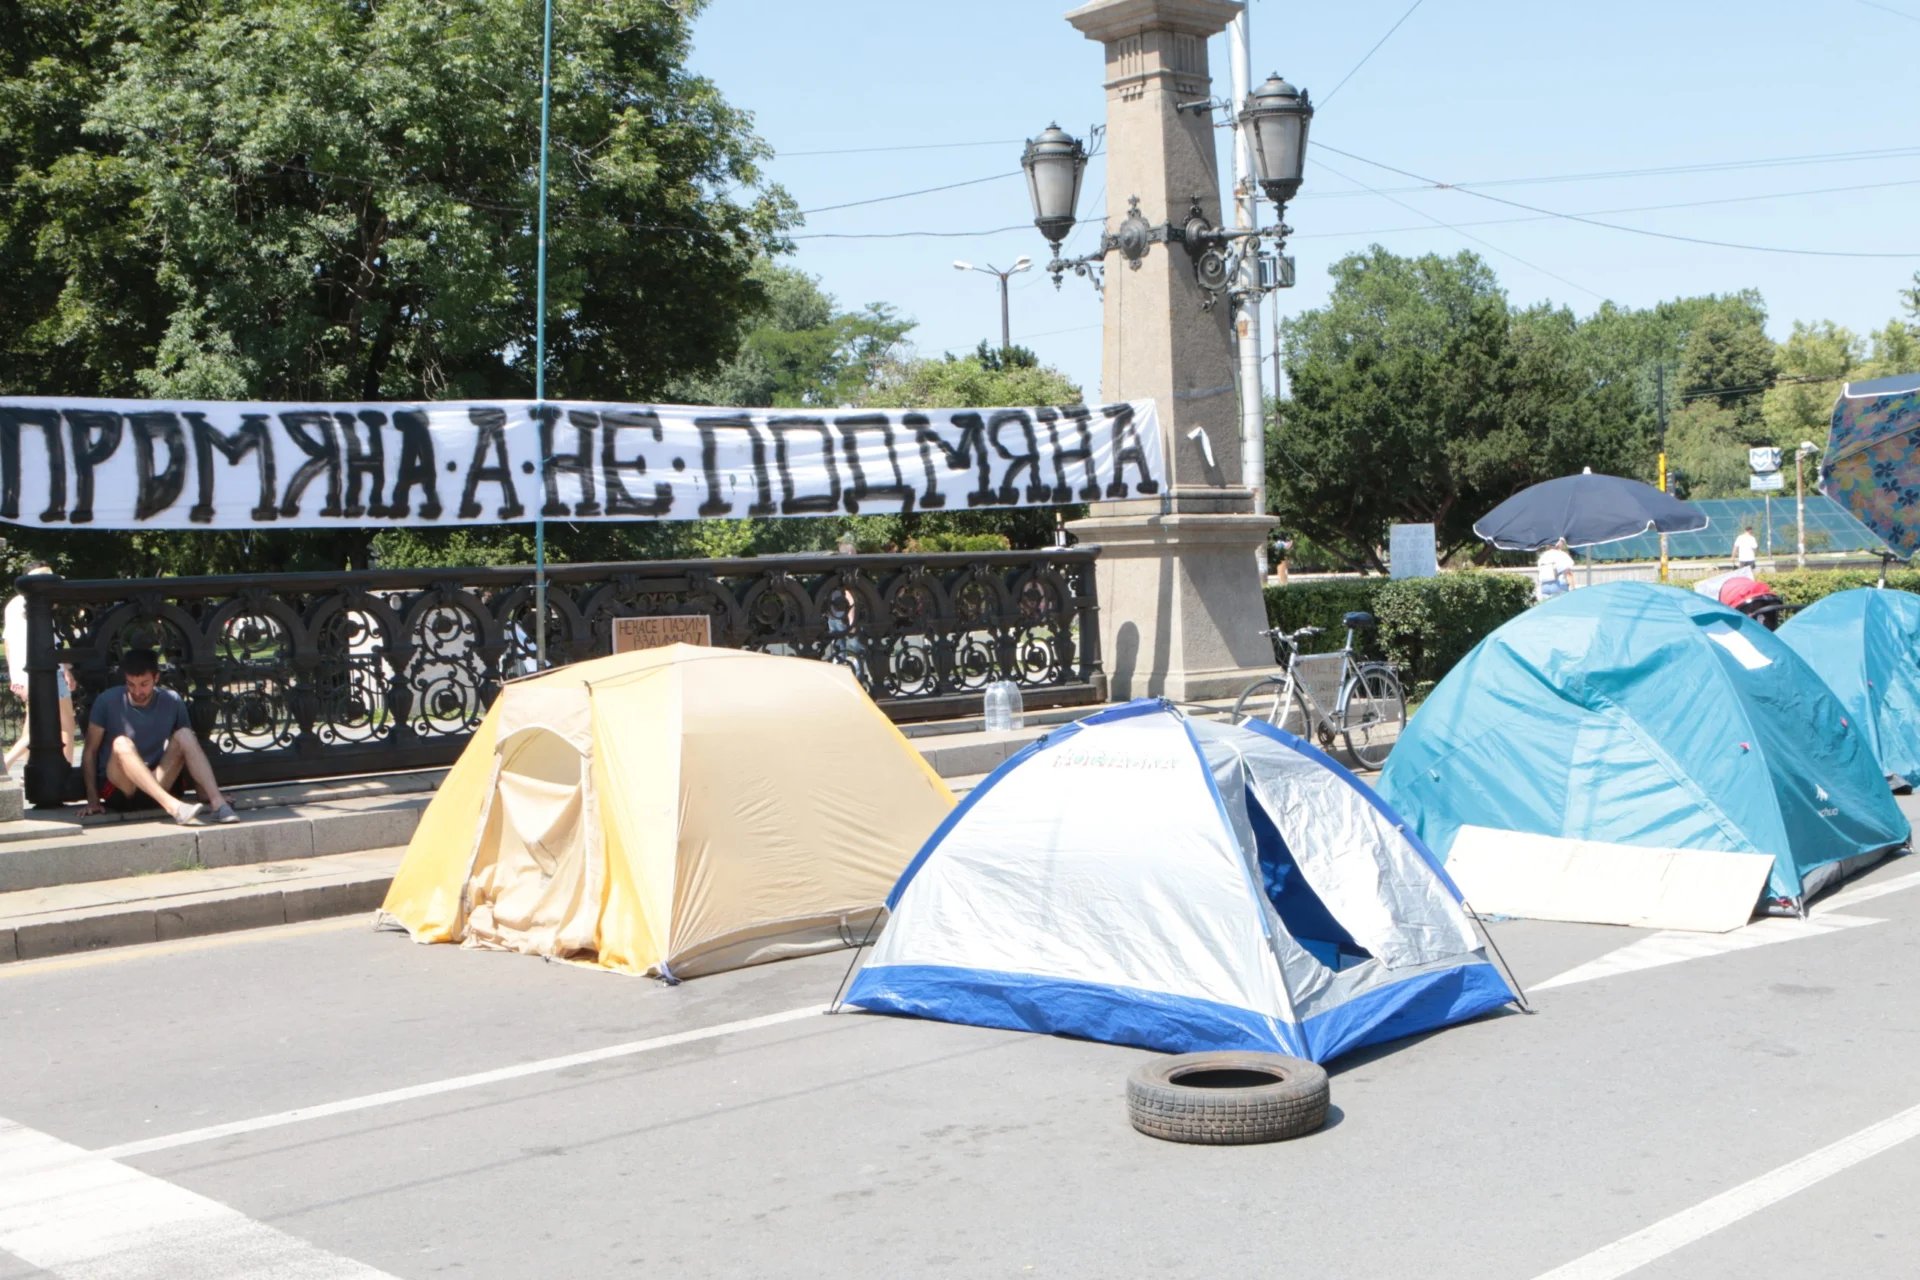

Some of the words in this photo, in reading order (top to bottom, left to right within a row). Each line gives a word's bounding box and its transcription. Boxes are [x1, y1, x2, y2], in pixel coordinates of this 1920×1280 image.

[0, 406, 443, 523] ПРОМЯНА
[530, 405, 673, 518] НЕ
[694, 402, 1159, 518] ПОДМЯНА
